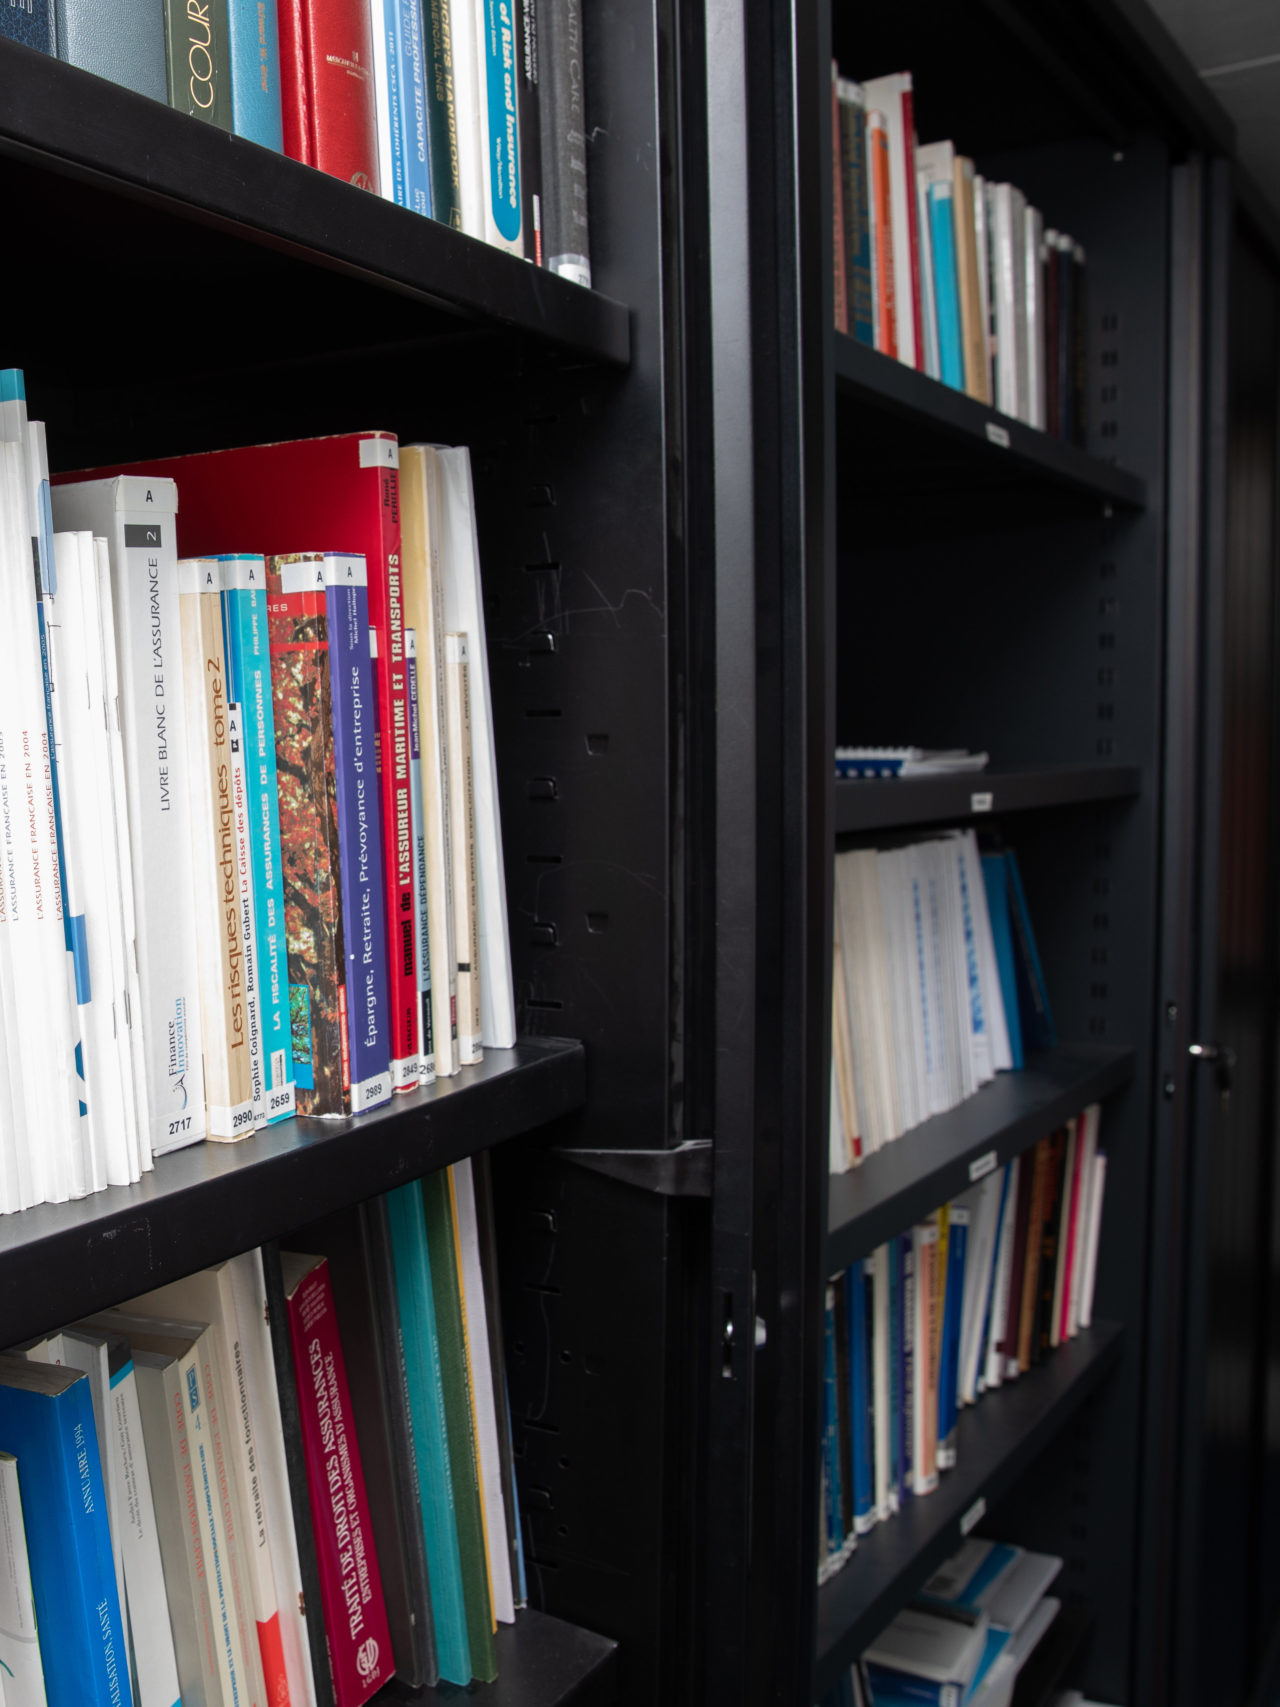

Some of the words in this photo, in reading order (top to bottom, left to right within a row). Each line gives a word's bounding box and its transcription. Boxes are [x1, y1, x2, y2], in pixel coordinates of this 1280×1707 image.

[403, 19, 413, 57] GUIDE
[499, 2, 511, 26] of
[501, 28, 513, 69] Risk
[503, 72, 516, 113] and
[445, 75, 460, 188] HANDBOOK
[504, 114, 517, 209] Insurance
[146, 556, 164, 669] L'ASSURANCE
[387, 554, 403, 664] TRANSPORTS
[154, 673, 165, 698] DE
[206, 656, 220, 674] 2
[391, 671, 404, 691] ET
[155, 704, 169, 762] BLANC
[211, 677, 226, 748] tome
[255, 669, 266, 758] PERSONNES
[351, 666, 365, 774] d'entreprise
[393, 697, 408, 780] MARITIME
[159, 765, 171, 812] LIVRE
[259, 763, 268, 786] DE
[215, 763, 238, 905] techniques
[262, 792, 274, 891] ASSURANCES
[354, 778, 370, 882] Prévoyance
[396, 787, 412, 886] L'ASSUREUR
[416, 834, 428, 906] DÉPENDANCE
[266, 897, 277, 928] DES
[361, 887, 373, 965] Retraite,
[401, 891, 411, 912] de
[223, 908, 244, 1001] risques
[268, 933, 280, 1005] FISCALITÉ
[404, 918, 414, 977] manuel
[419, 909, 431, 983] L'ASSURANCE
[175, 997, 187, 1075] Innovation
[230, 1003, 245, 1050] Les
[272, 1010, 282, 1031] LA
[363, 970, 378, 1049] Épargne,
[168, 1020, 177, 1077] Finance
[233, 1108, 253, 1128] 2990
[270, 1091, 291, 1110] 2659
[365, 1083, 383, 1101] 2989
[169, 1116, 192, 1136] 2717
[232, 1340, 251, 1446] fonctionnaires
[308, 1338, 335, 1454] ASSURANCES
[323, 1351, 346, 1437] D'ASSURANCE
[73, 1422, 85, 1454] 1994
[246, 1448, 256, 1473] des
[77, 1456, 95, 1515] ANNUAIRE
[325, 1454, 342, 1486] DES
[336, 1434, 358, 1509] ORGANISMES
[251, 1475, 262, 1526] retraite
[328, 1486, 350, 1547] DROIT
[348, 1510, 361, 1526] ET
[258, 1533, 266, 1548] La
[338, 1546, 356, 1578] DE
[350, 1526, 372, 1605] ENTREPRISES
[340, 1577, 365, 1640] TRAITÉ
